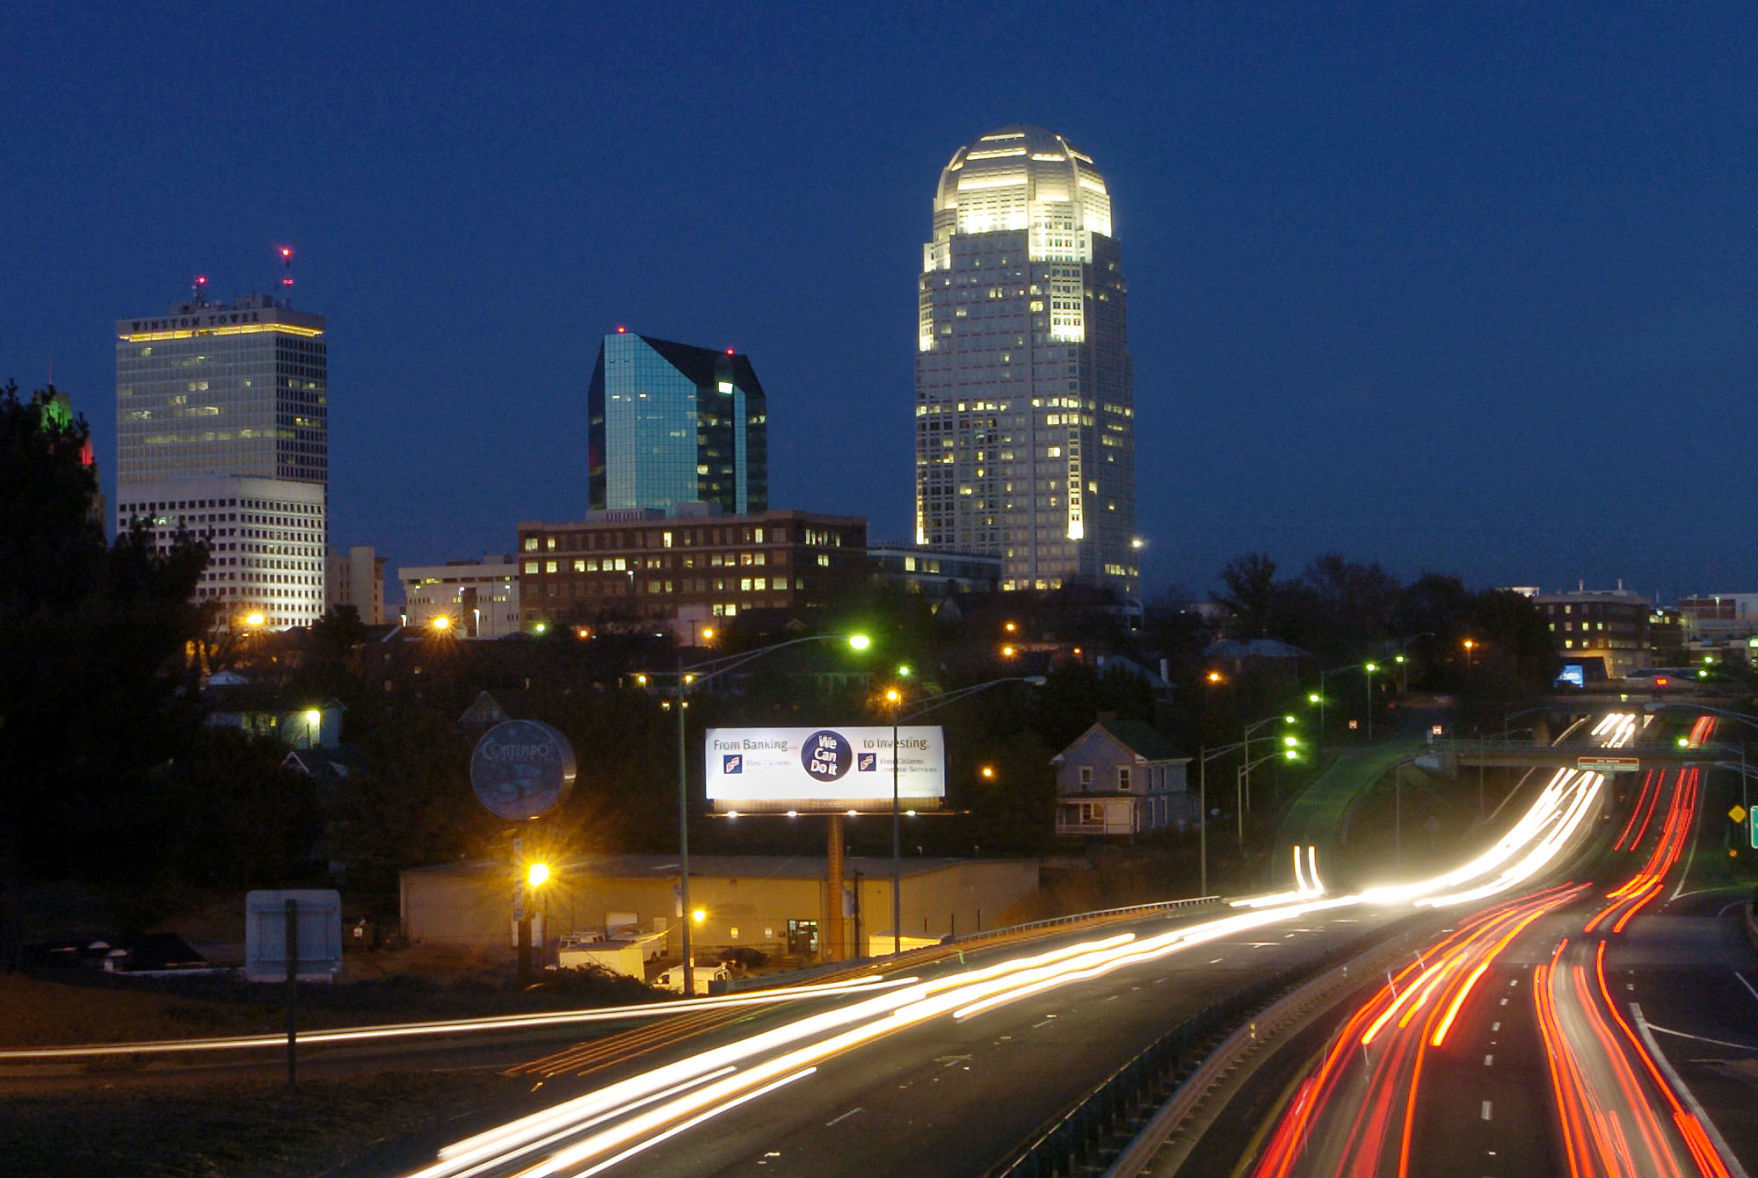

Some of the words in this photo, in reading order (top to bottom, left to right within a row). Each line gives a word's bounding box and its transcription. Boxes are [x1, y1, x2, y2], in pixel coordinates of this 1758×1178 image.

[132, 317, 200, 332] WINSTON
[208, 312, 259, 326] TOWER
[714, 739, 740, 750] From
[818, 735, 837, 749] We
[863, 739, 874, 749] to
[814, 747, 837, 762] Can
[810, 759, 827, 773] Do
[828, 762, 838, 775] It
